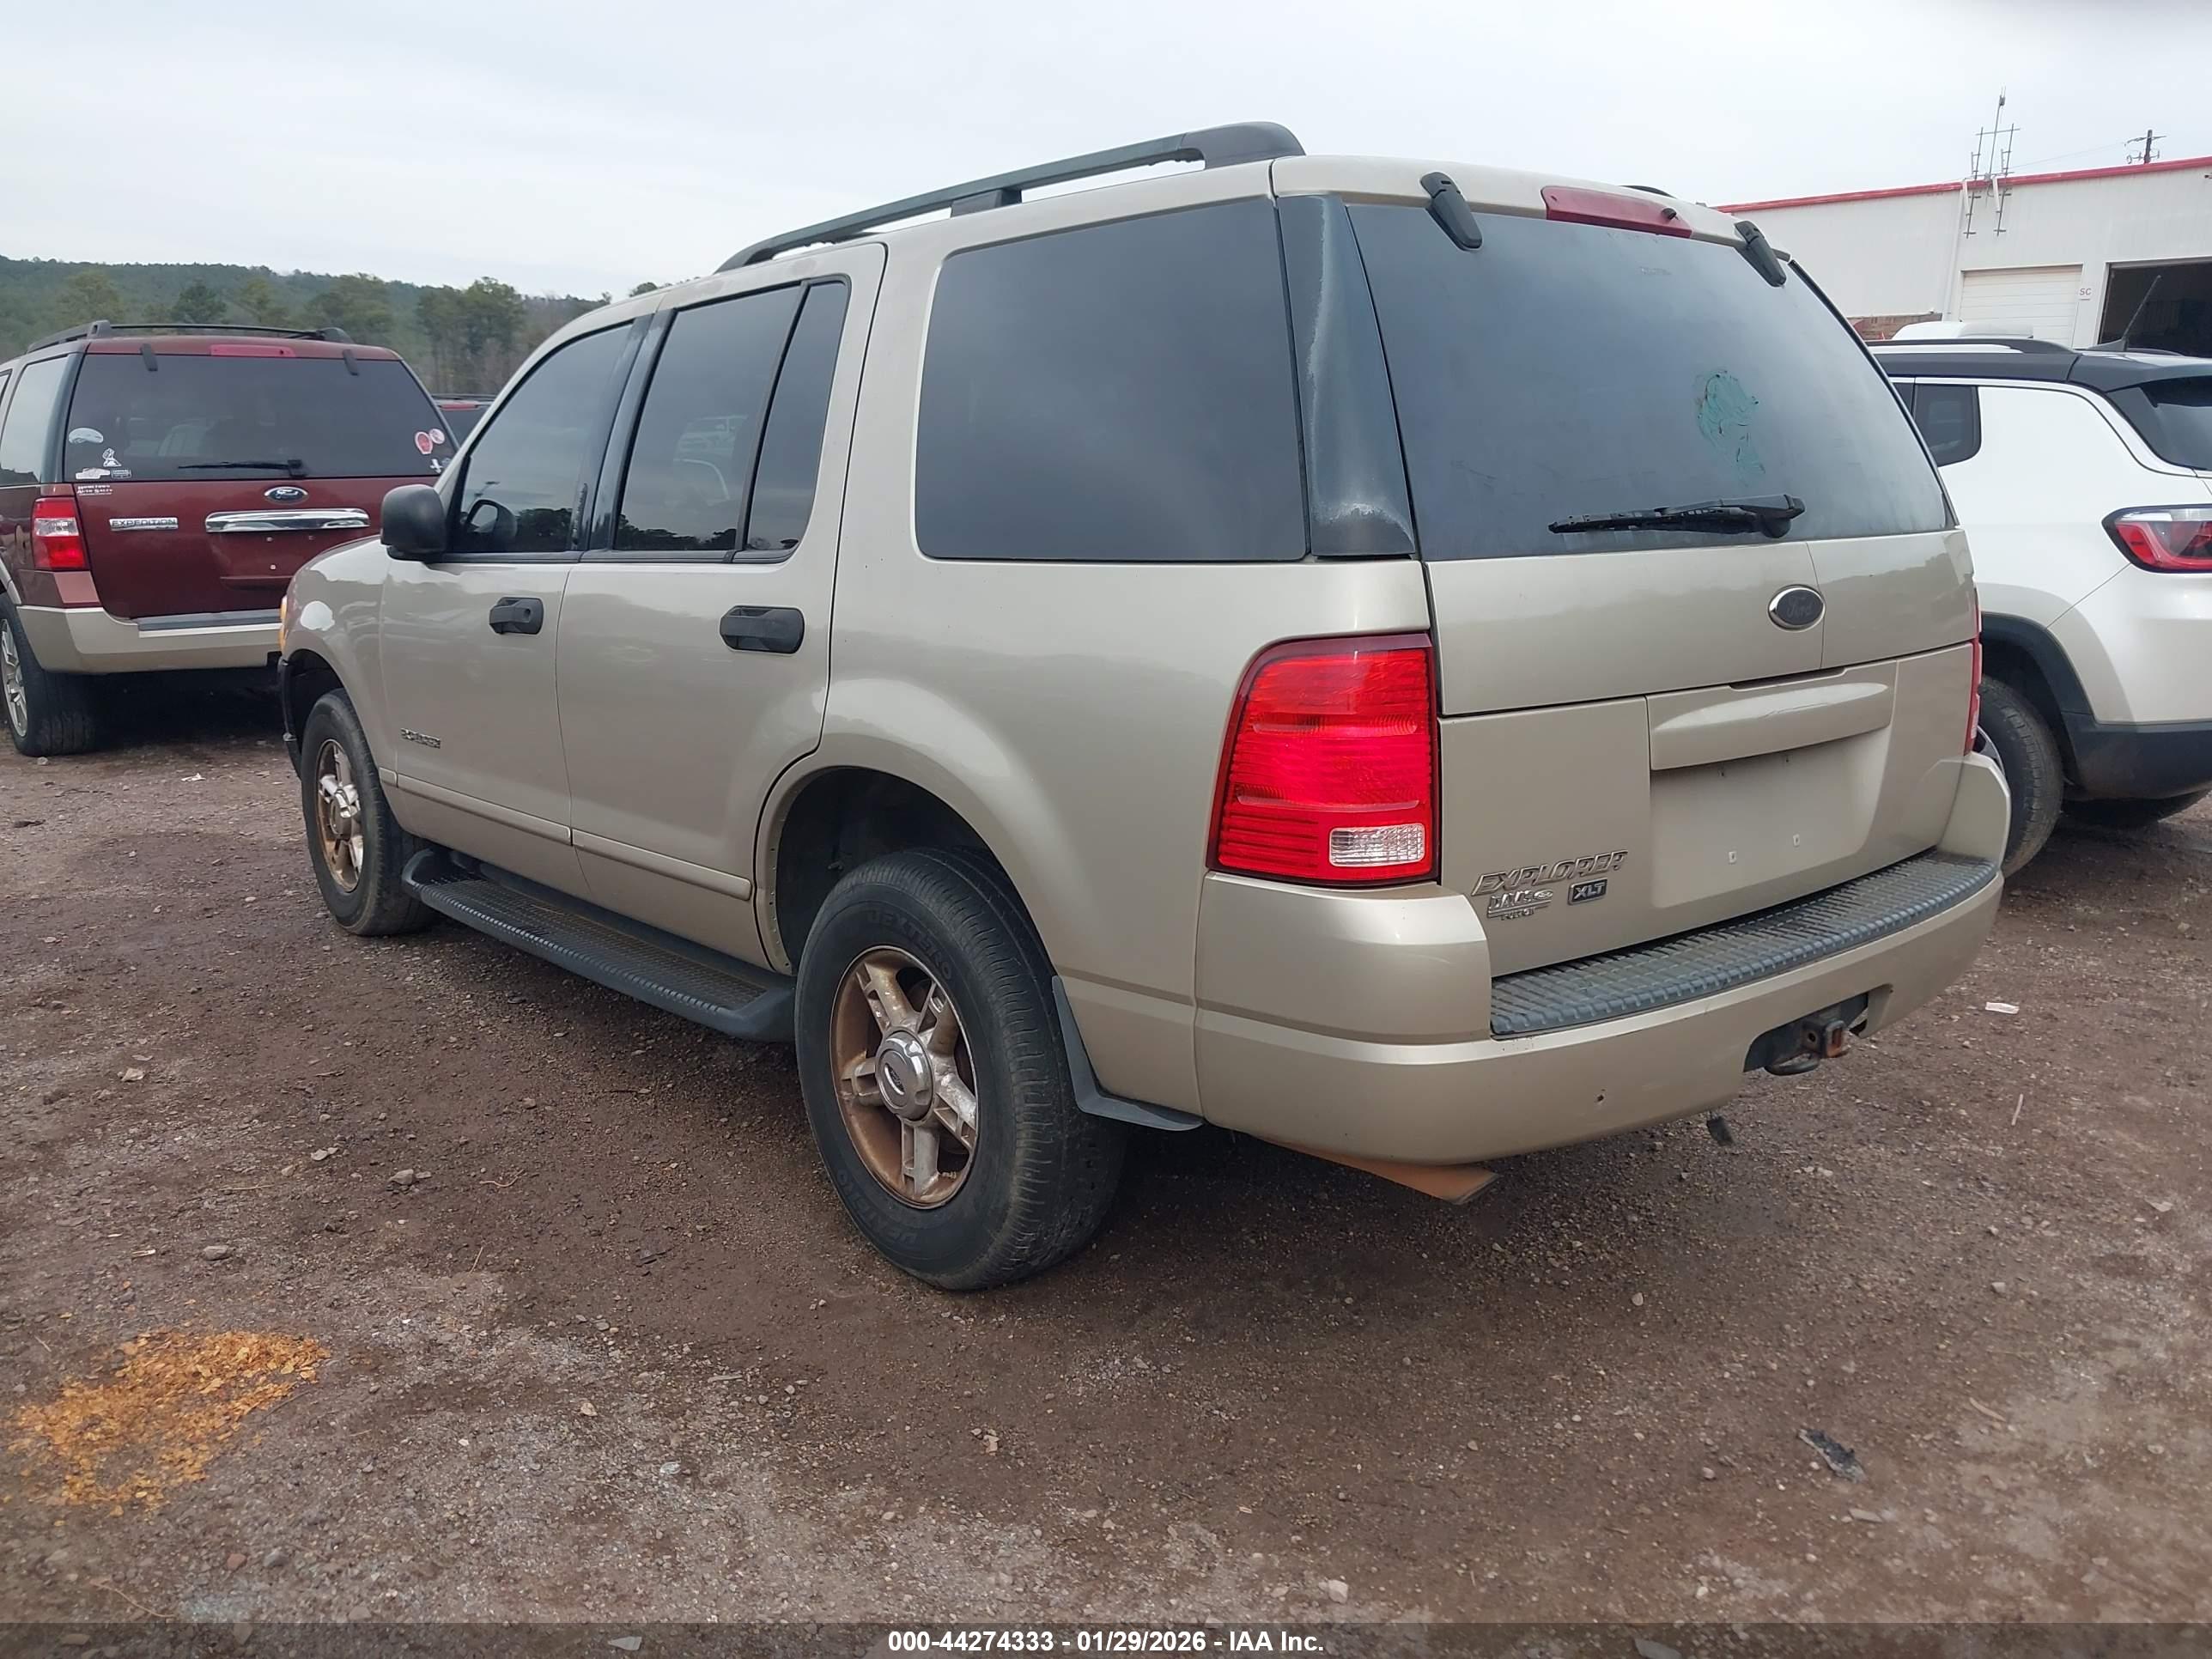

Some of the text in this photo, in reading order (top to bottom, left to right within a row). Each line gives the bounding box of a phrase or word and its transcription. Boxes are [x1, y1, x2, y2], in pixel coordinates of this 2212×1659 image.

[112, 519, 177, 528] EXPEDITION
[1471, 849, 1629, 896] EXPLORER
[1572, 881, 1606, 901] XLT
